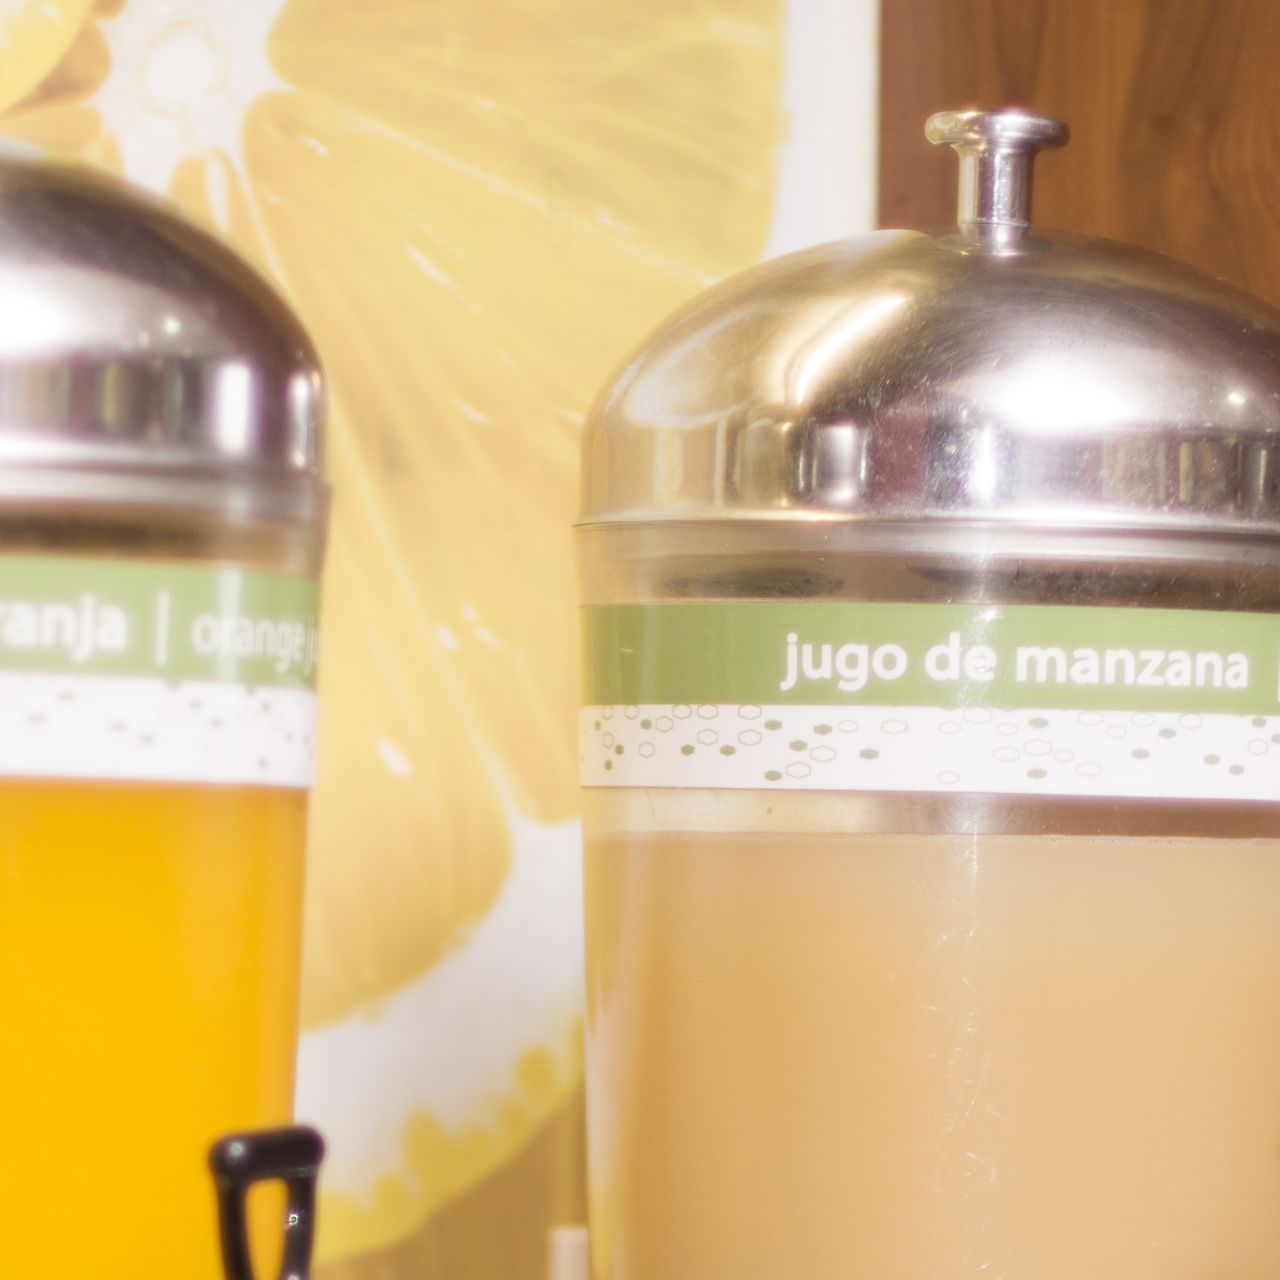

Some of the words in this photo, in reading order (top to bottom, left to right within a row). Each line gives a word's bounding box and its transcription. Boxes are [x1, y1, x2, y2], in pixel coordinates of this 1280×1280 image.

[780, 632, 908, 698] jugo
[924, 633, 997, 682] de
[1015, 641, 1249, 692] manzana
